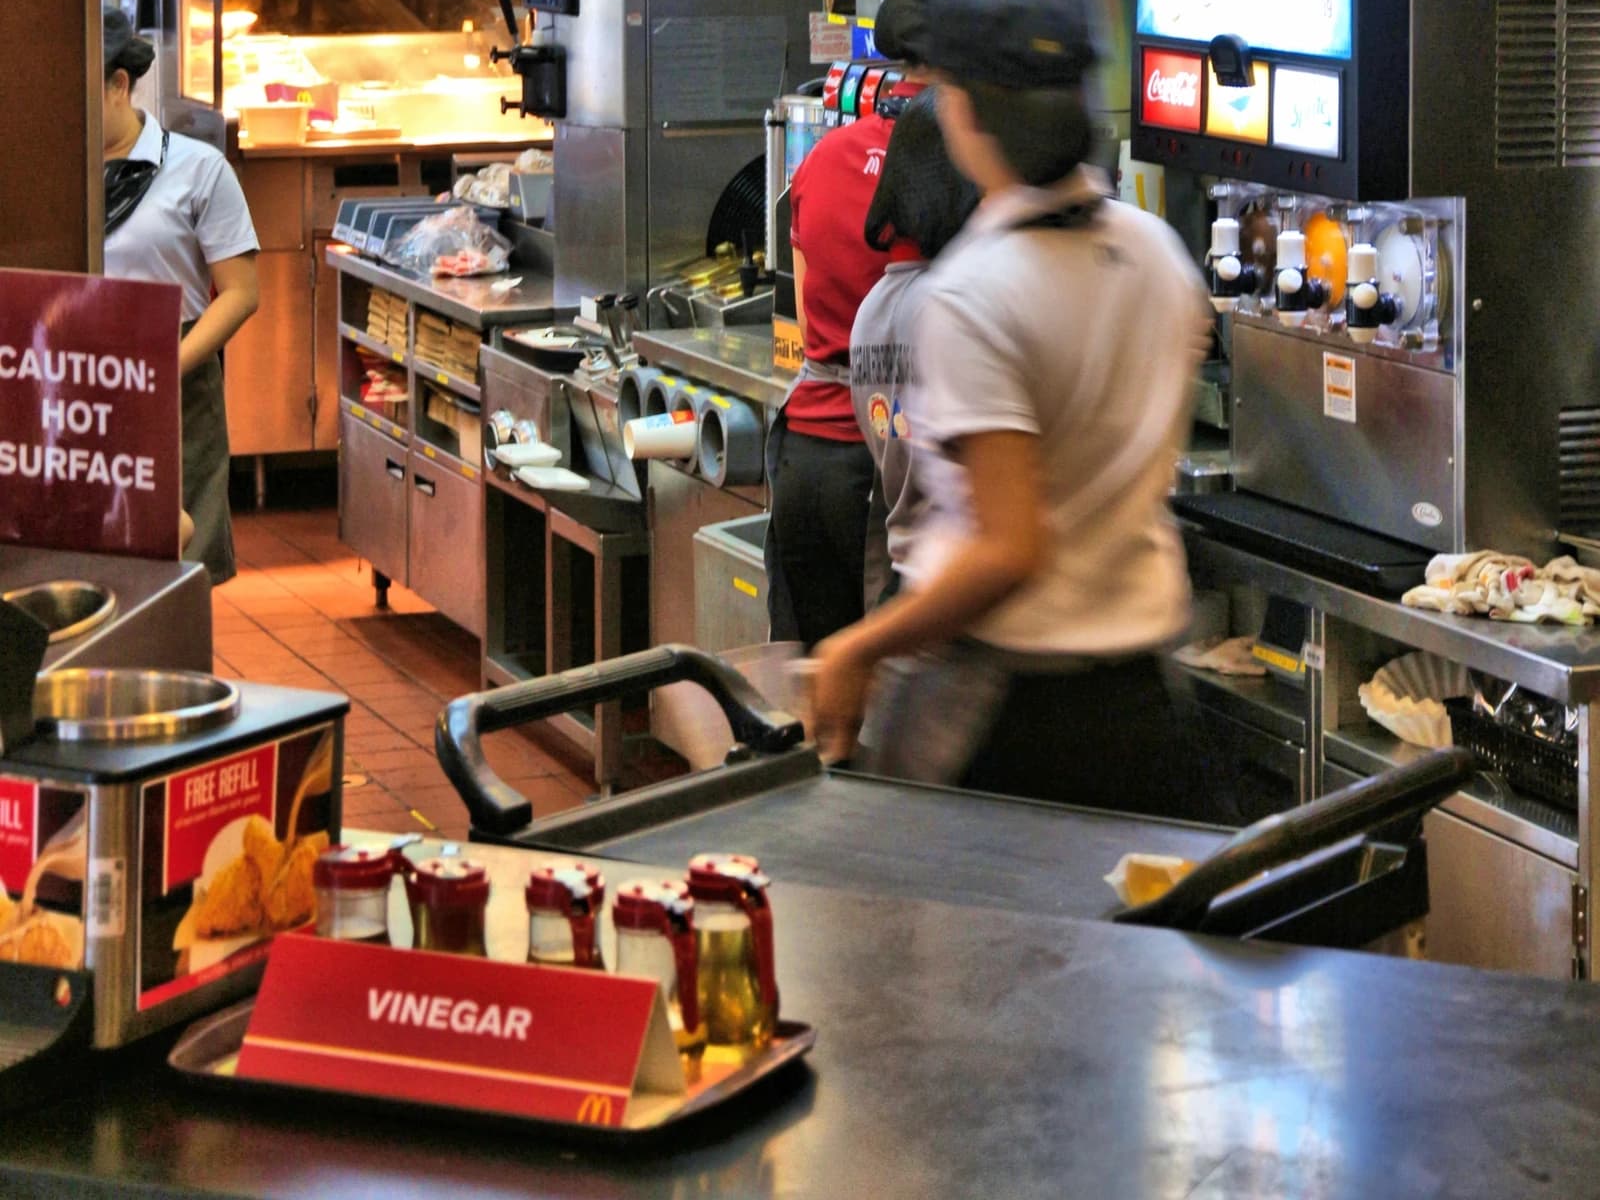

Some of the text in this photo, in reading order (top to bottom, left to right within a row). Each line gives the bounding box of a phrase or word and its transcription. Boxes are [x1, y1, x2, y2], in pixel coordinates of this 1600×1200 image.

[0, 345, 156, 393] CAUTION:
[41, 398, 113, 436] HOT
[0, 440, 156, 491] SURFACE
[184, 769, 217, 812] FREE
[218, 757, 260, 800] REFILL
[366, 987, 533, 1042] VINEGAR
